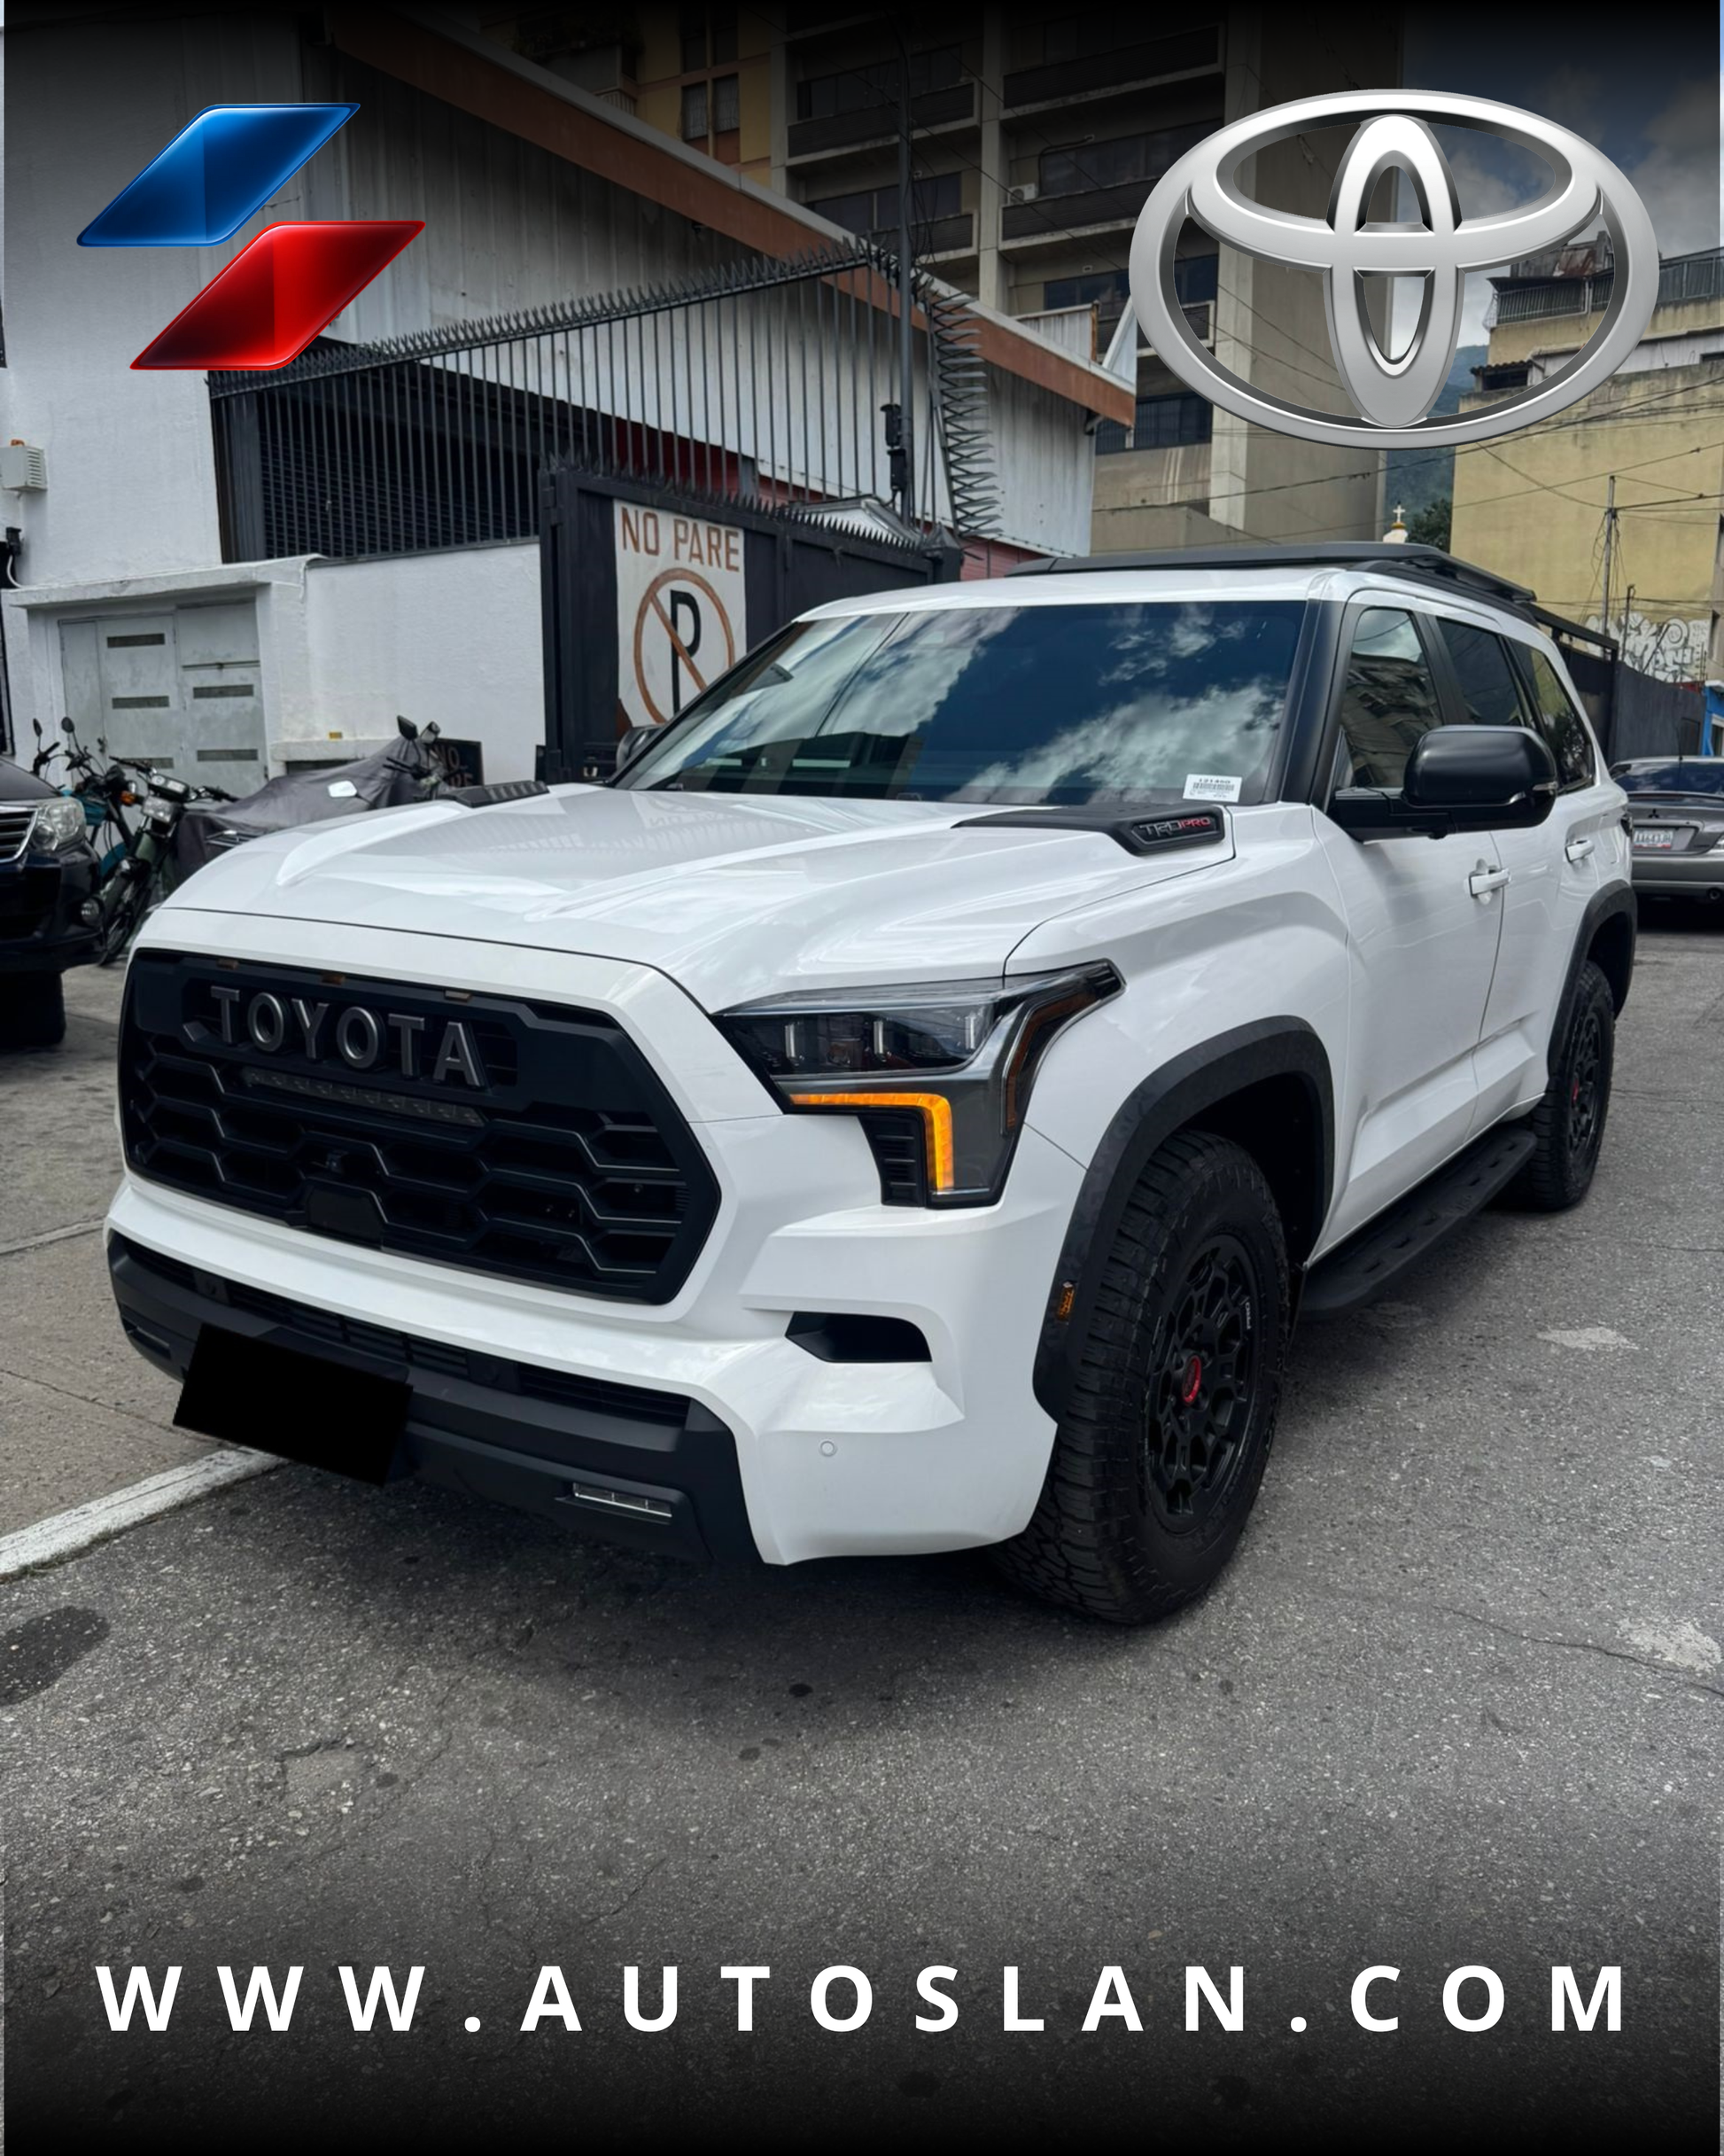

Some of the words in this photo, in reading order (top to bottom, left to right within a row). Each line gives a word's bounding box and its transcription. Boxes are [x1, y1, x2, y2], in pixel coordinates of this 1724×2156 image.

[621, 506, 659, 557] NO
[673, 518, 739, 572] PARE
[211, 985, 482, 1087] TOYOTA
